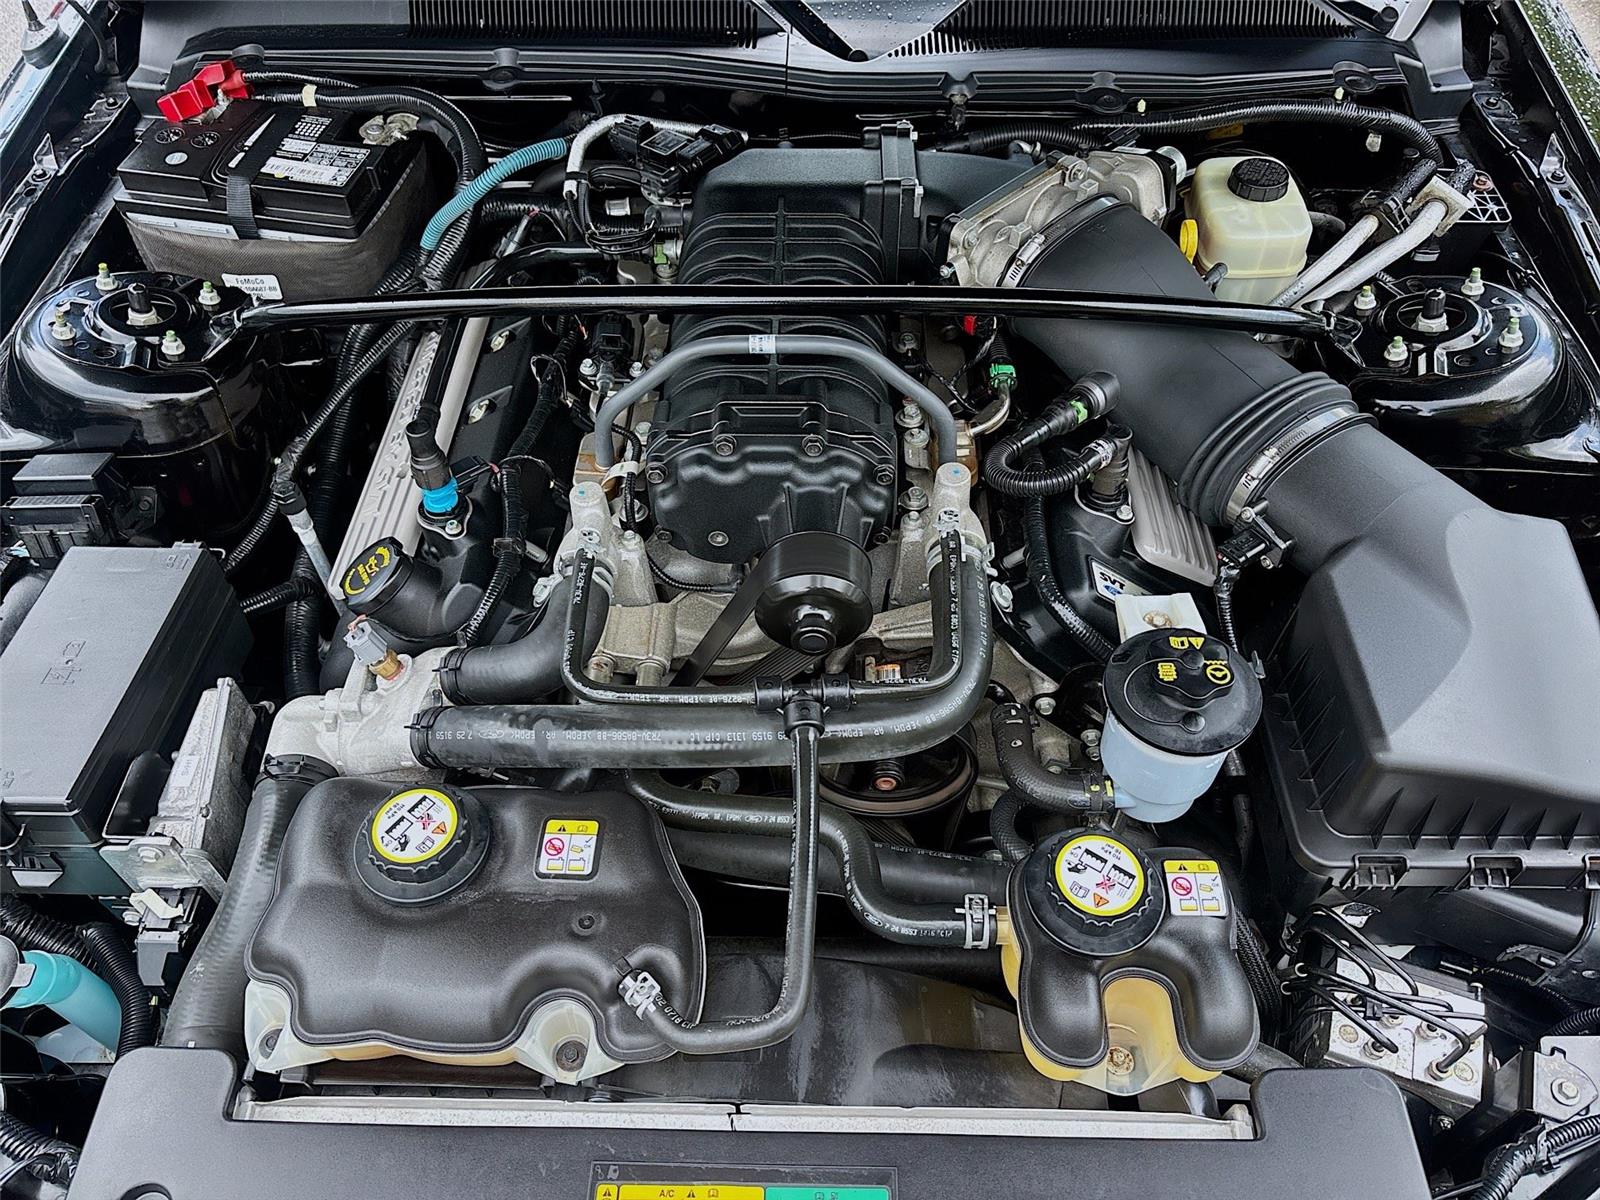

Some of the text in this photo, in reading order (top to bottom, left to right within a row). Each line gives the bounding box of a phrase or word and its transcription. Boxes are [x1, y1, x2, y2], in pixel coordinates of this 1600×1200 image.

[1099, 571, 1126, 590] SVT
[435, 730, 453, 740] 9159
[726, 732, 746, 741] 1313
[752, 731, 773, 741] 9159
[659, 1190, 674, 1198] A/C
